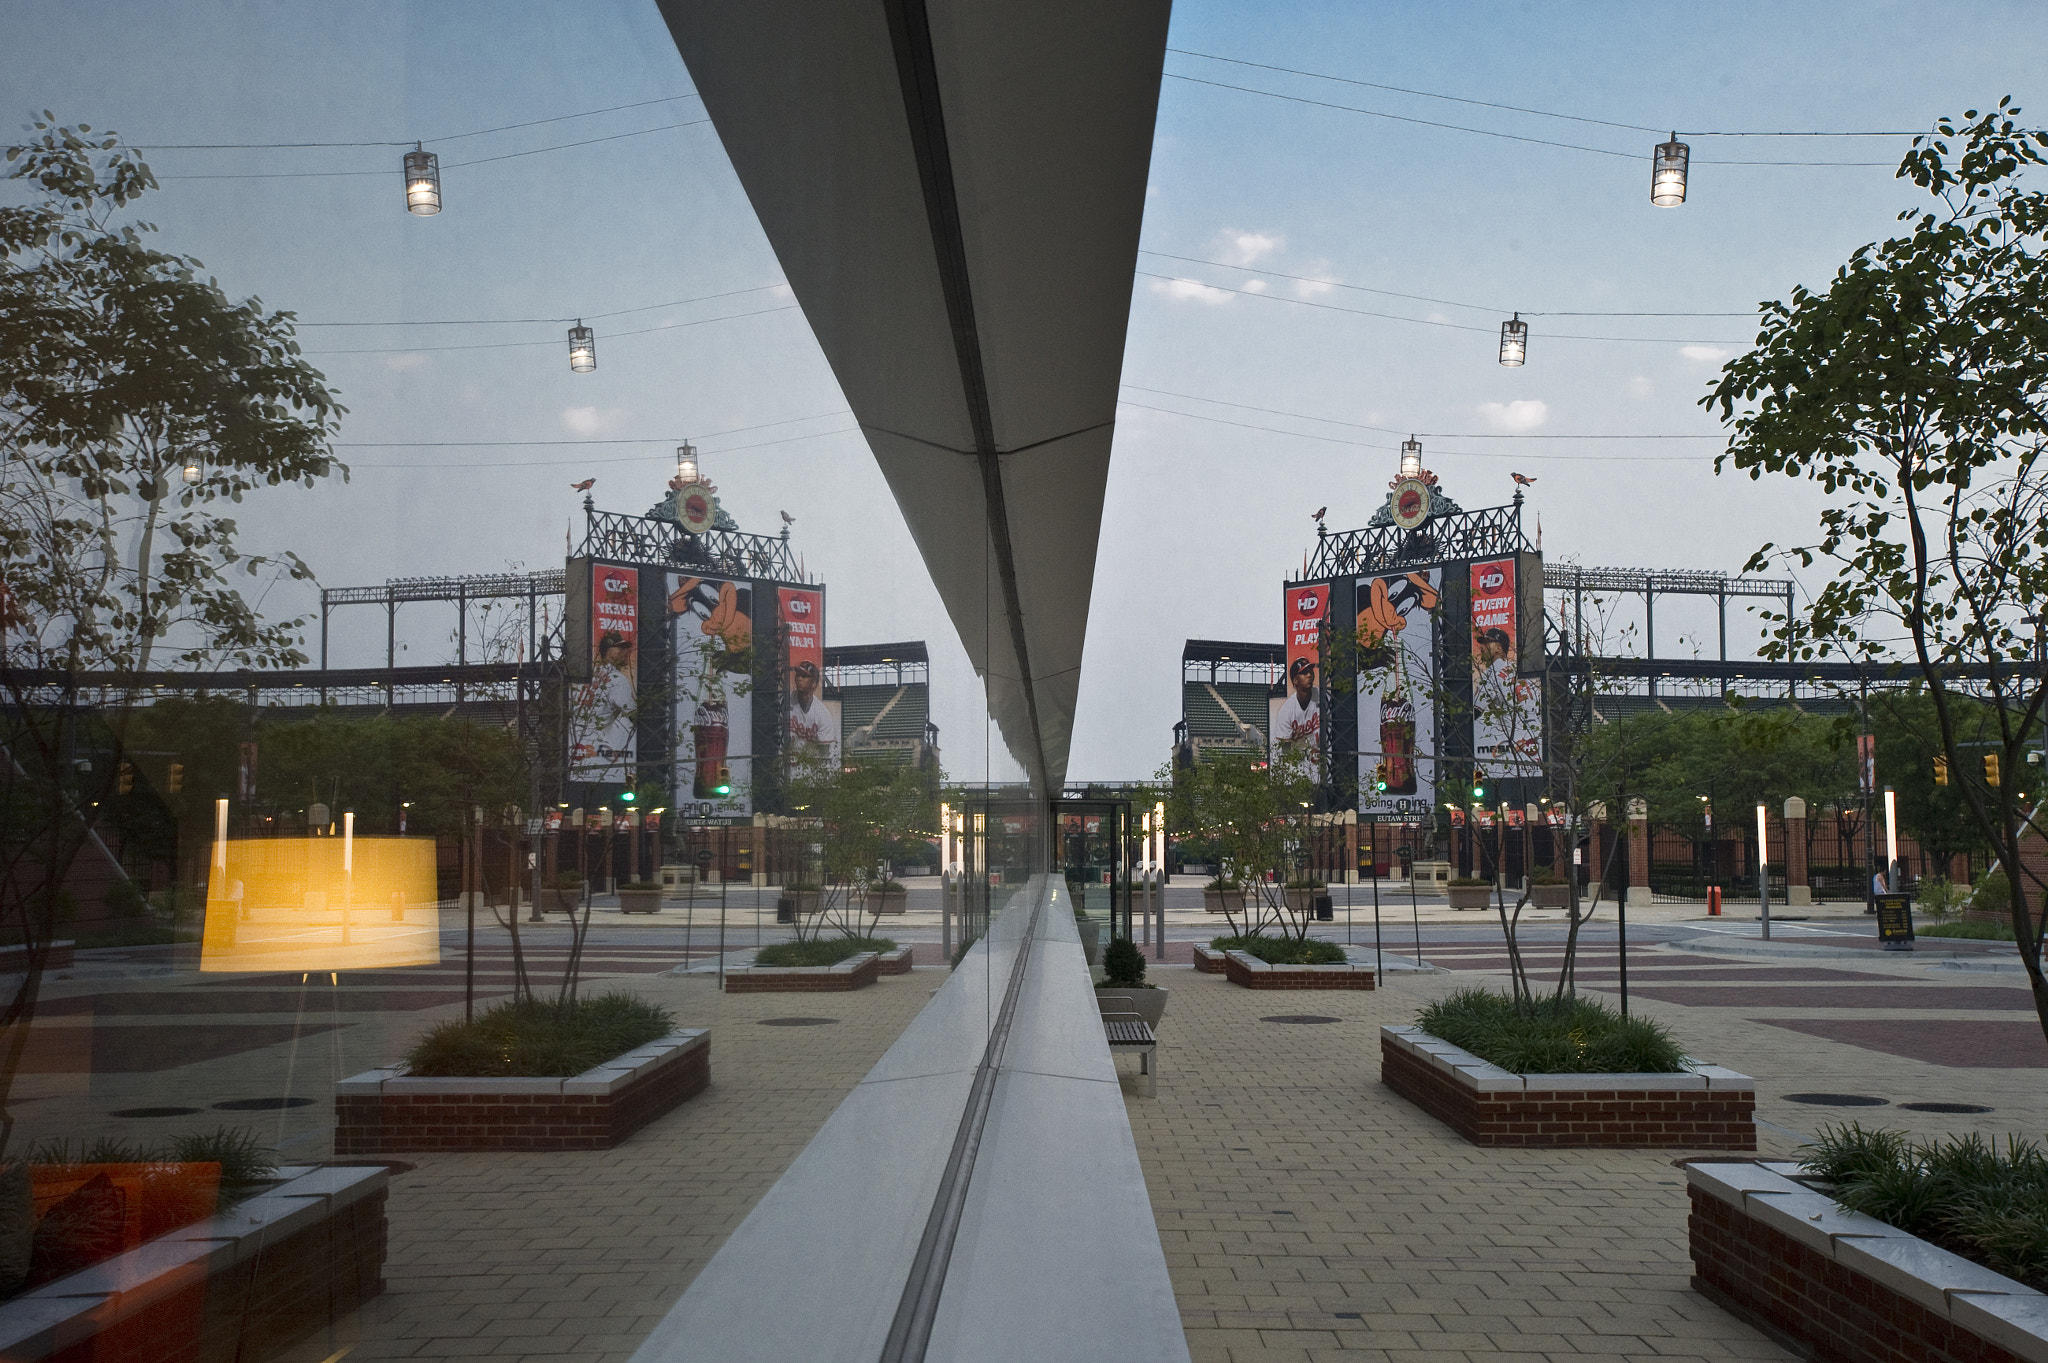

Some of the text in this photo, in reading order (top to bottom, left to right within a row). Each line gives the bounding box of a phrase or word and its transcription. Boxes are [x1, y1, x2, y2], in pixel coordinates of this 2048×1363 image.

[1480, 574, 1504, 588] HD
[1297, 597, 1319, 610] HD
[1474, 597, 1511, 612] EVERY
[1476, 612, 1509, 627] GAME
[1295, 632, 1319, 645] PLAY
